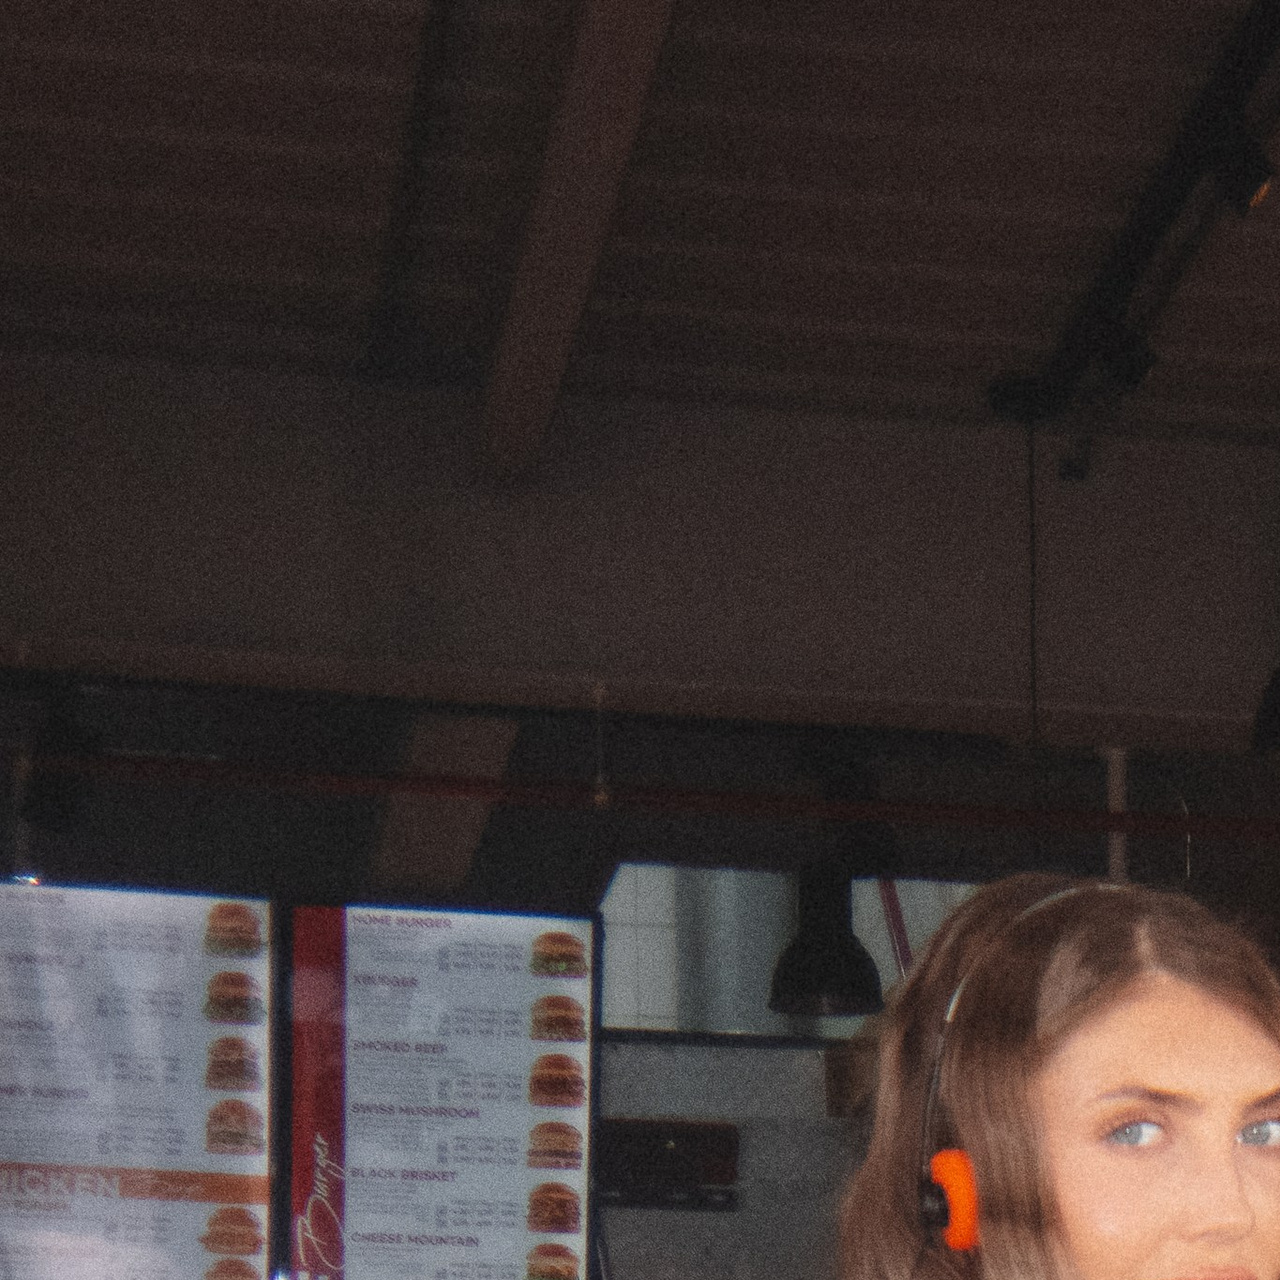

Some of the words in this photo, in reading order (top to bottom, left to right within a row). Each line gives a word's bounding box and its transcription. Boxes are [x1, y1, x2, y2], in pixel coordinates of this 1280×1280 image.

[351, 1168, 396, 1180] BLACK
[401, 1170, 457, 1182] BRISKET
[297, 1133, 346, 1270] Burger
[350, 1232, 402, 1245] CHEESE
[407, 1235, 479, 1247] MOUNTAIN
